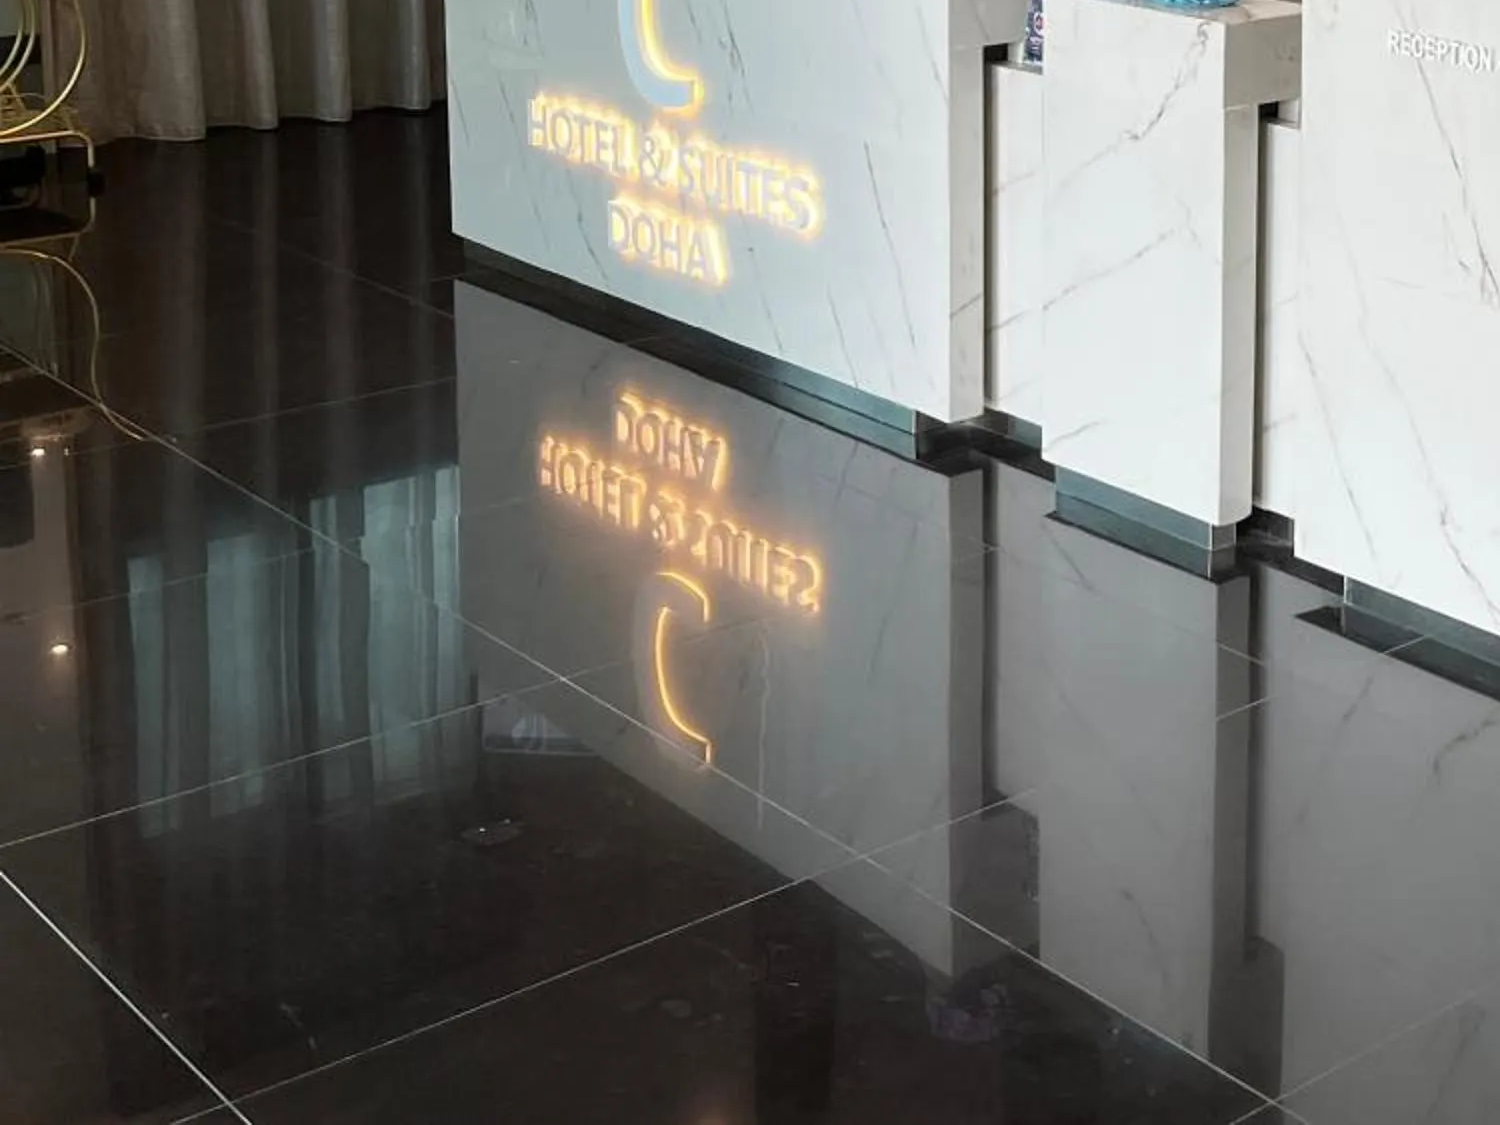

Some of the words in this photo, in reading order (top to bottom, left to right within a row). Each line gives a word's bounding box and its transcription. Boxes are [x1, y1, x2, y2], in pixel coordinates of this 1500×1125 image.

[1387, 30, 1495, 73] RECEPTION
[527, 95, 638, 179] HOTEL
[639, 127, 678, 189] &
[680, 139, 824, 237] SUITES
[608, 195, 729, 285] DOHA
